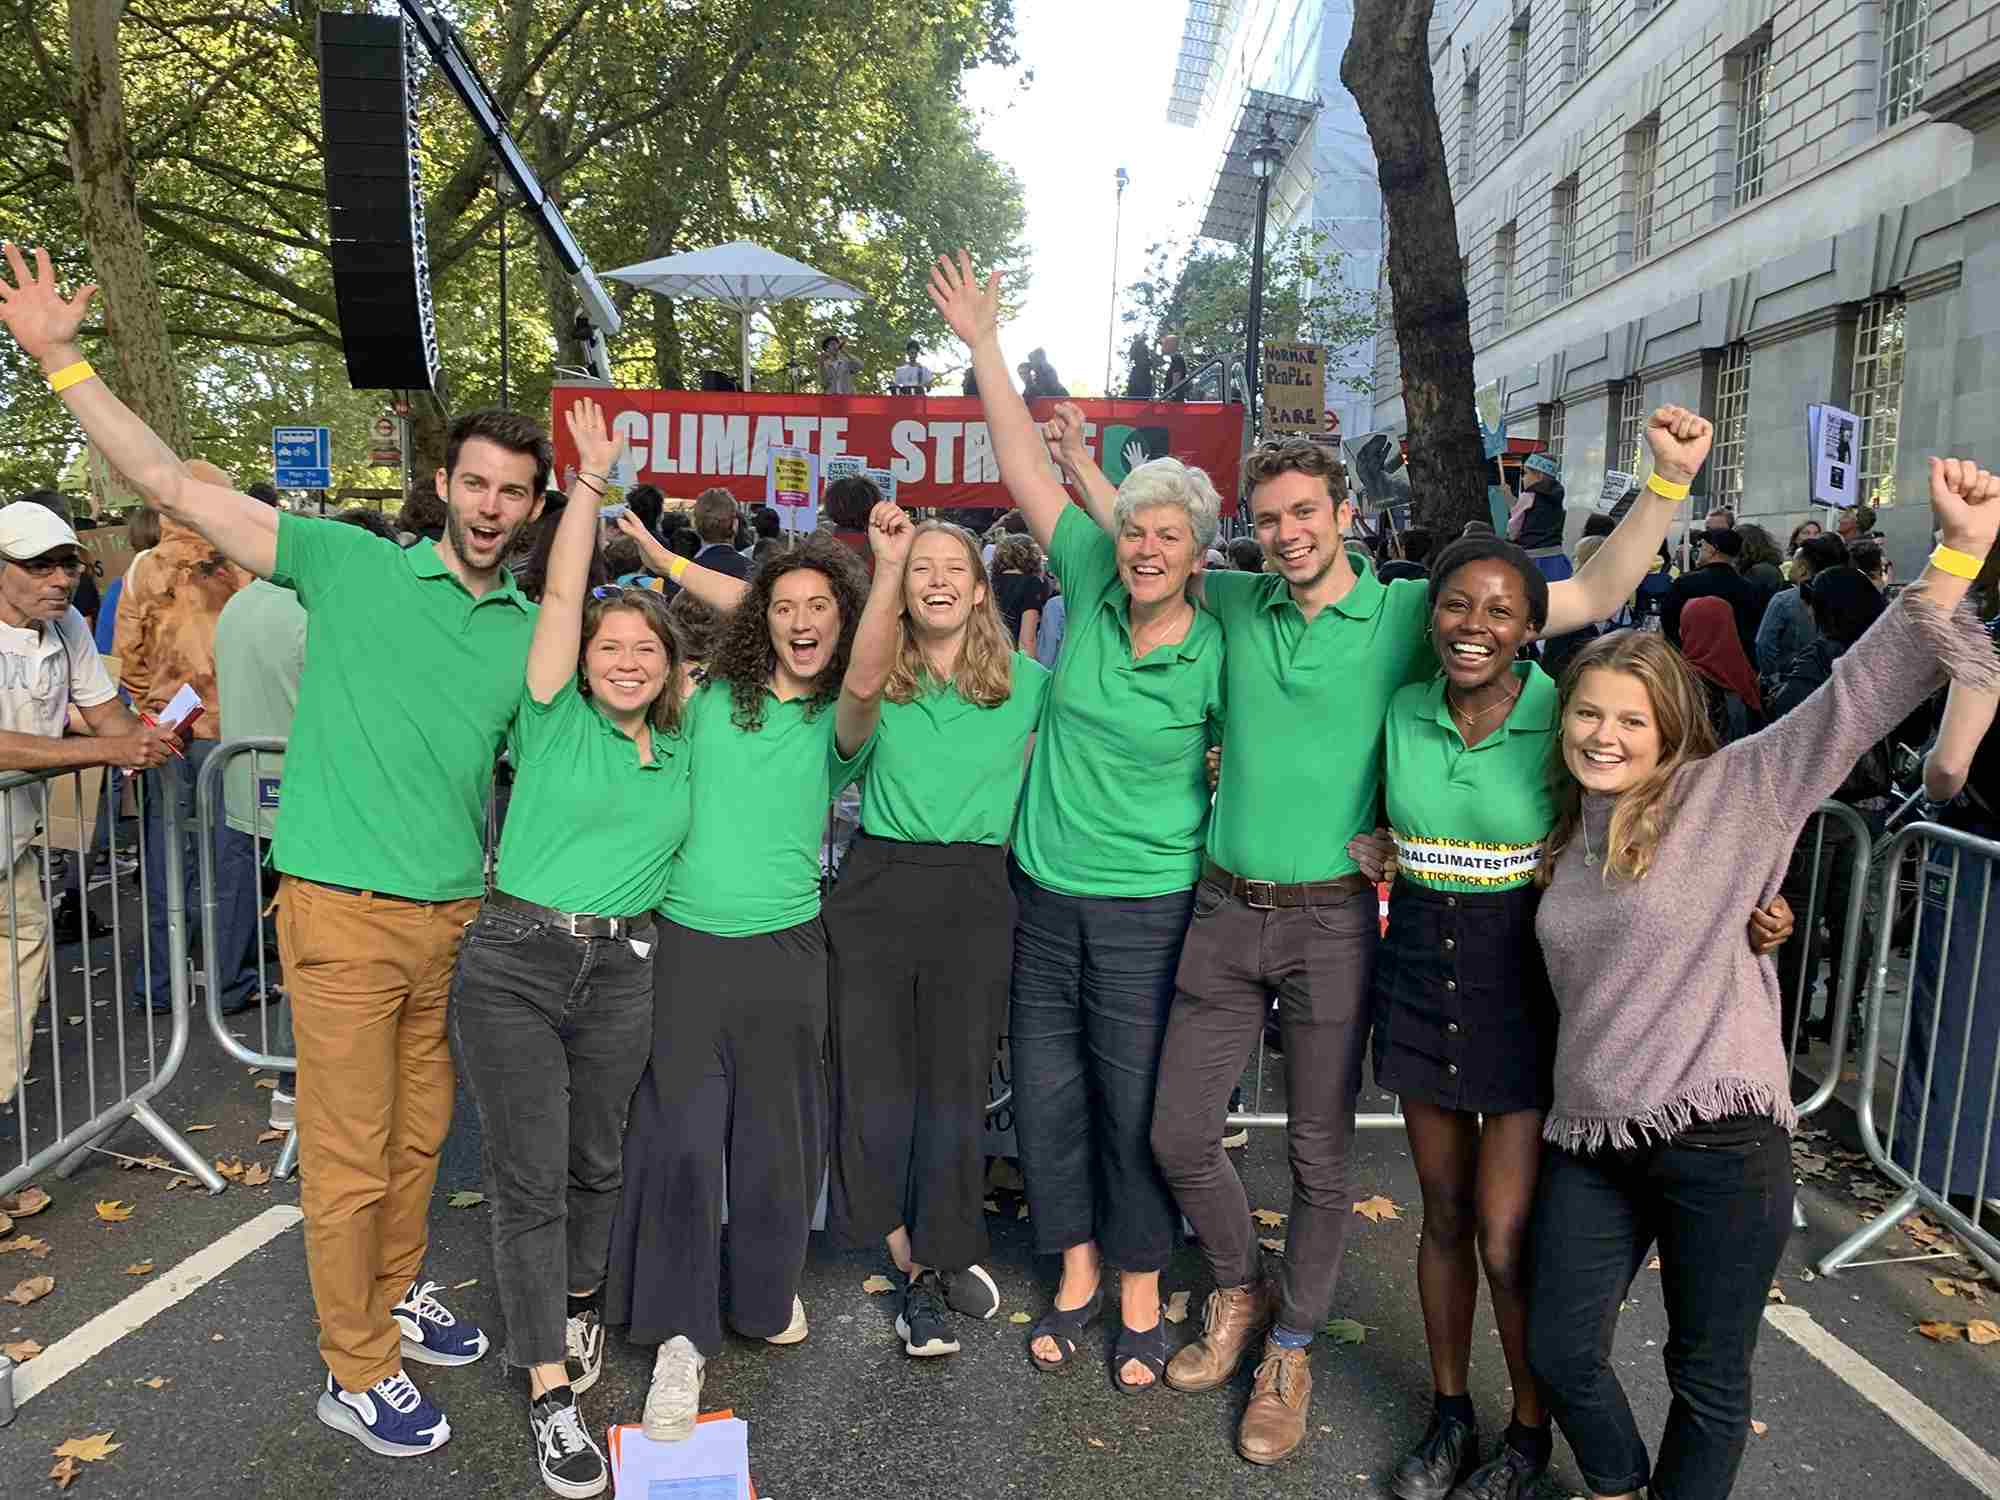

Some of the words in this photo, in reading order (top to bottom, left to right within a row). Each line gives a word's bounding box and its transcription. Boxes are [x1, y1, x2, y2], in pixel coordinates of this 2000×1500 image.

[612, 411, 848, 478] CLIMATE
[891, 420, 1097, 485] STRE
[1416, 836, 1439, 845] TICK
[1443, 838, 1471, 848] TOCK
[1474, 841, 1500, 851] TICK
[1427, 871, 1450, 881] TICK
[1453, 874, 1482, 885] TOCK
[1513, 868, 1537, 881] TOC
